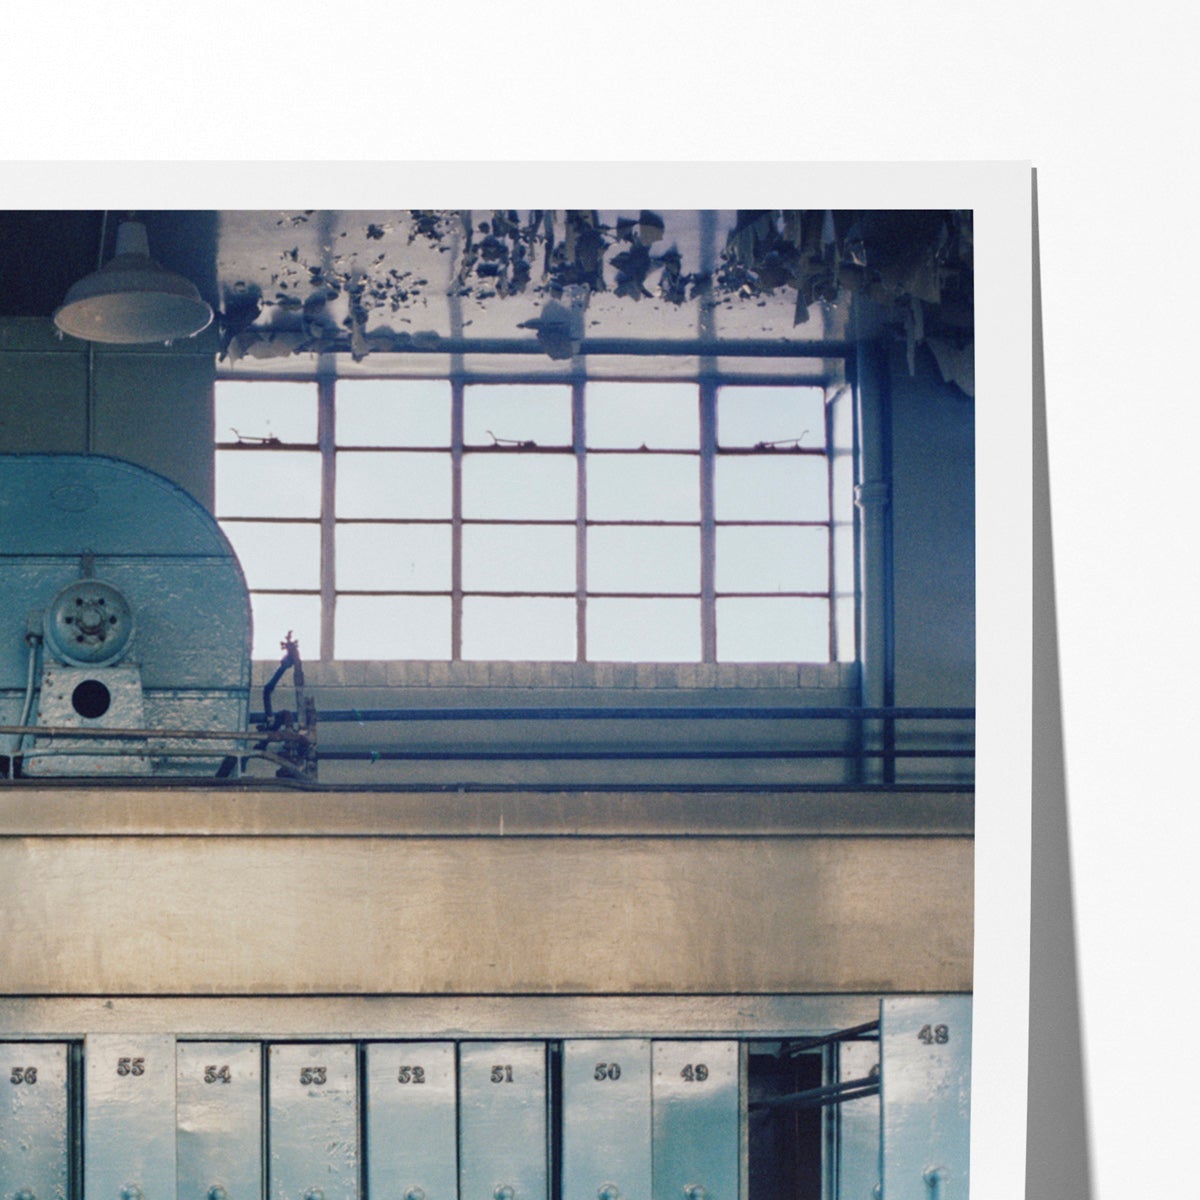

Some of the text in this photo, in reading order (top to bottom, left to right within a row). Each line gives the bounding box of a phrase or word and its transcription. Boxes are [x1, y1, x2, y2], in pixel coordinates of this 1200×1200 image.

[917, 1024, 950, 1045] 48
[9, 1066, 38, 1086] 56
[116, 1057, 145, 1077] 55
[203, 1065, 232, 1085] 54
[299, 1066, 327, 1086] 53
[397, 1065, 426, 1085] 52
[490, 1065, 514, 1084] 51
[593, 1062, 622, 1082] 50
[680, 1063, 709, 1083] 49
